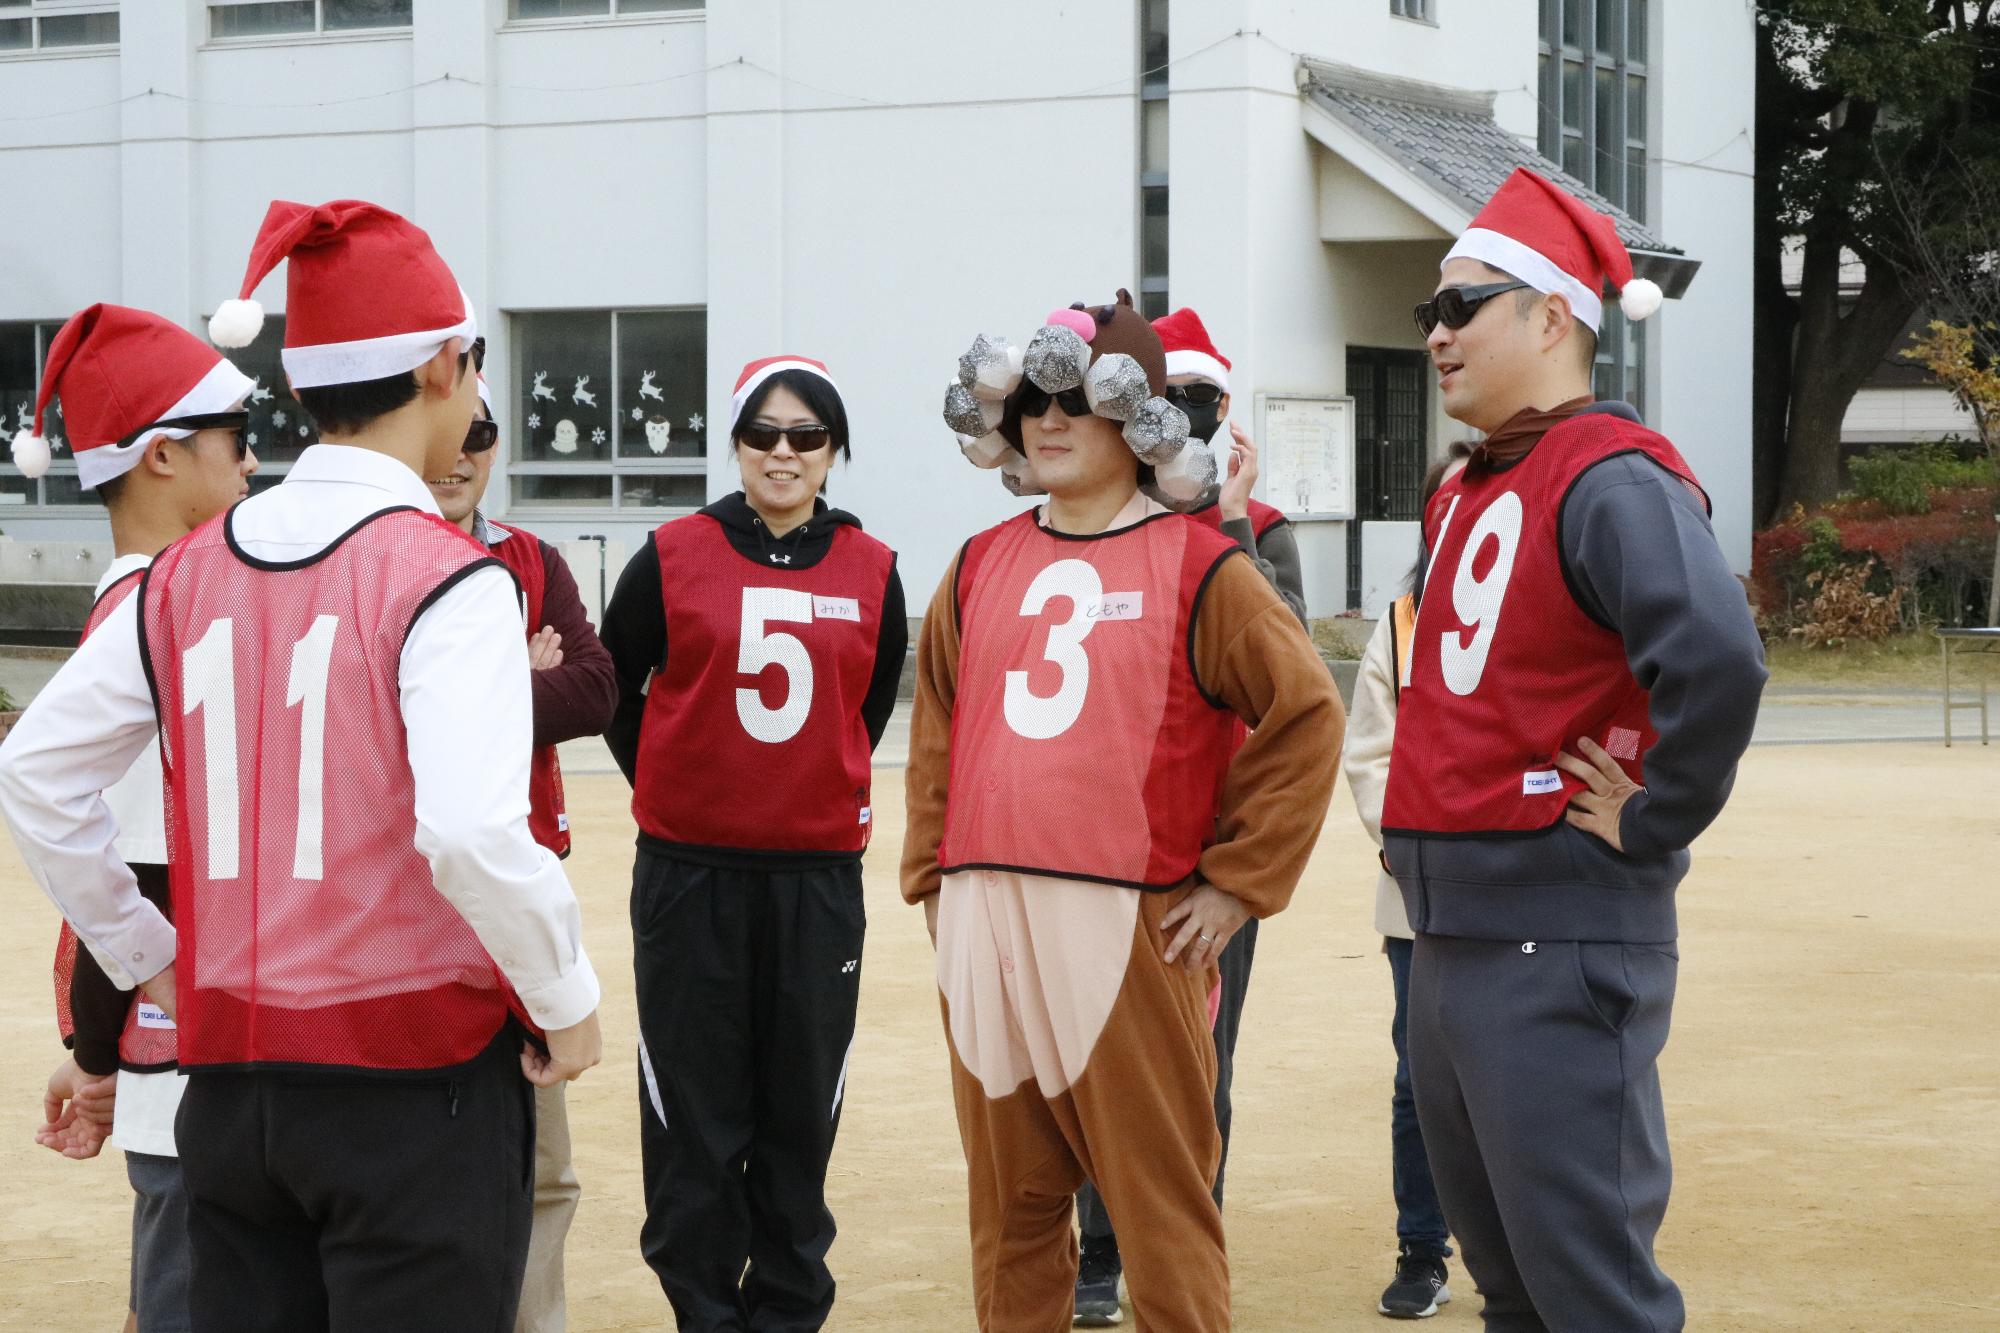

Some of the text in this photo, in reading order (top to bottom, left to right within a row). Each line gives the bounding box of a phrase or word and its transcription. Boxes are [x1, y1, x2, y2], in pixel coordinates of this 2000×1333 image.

[735, 586, 814, 744] 5
[820, 603, 850, 614] みか
[1003, 558, 1103, 740] 3
[1086, 602, 1129, 618] ともや
[182, 613, 340, 881] 11
